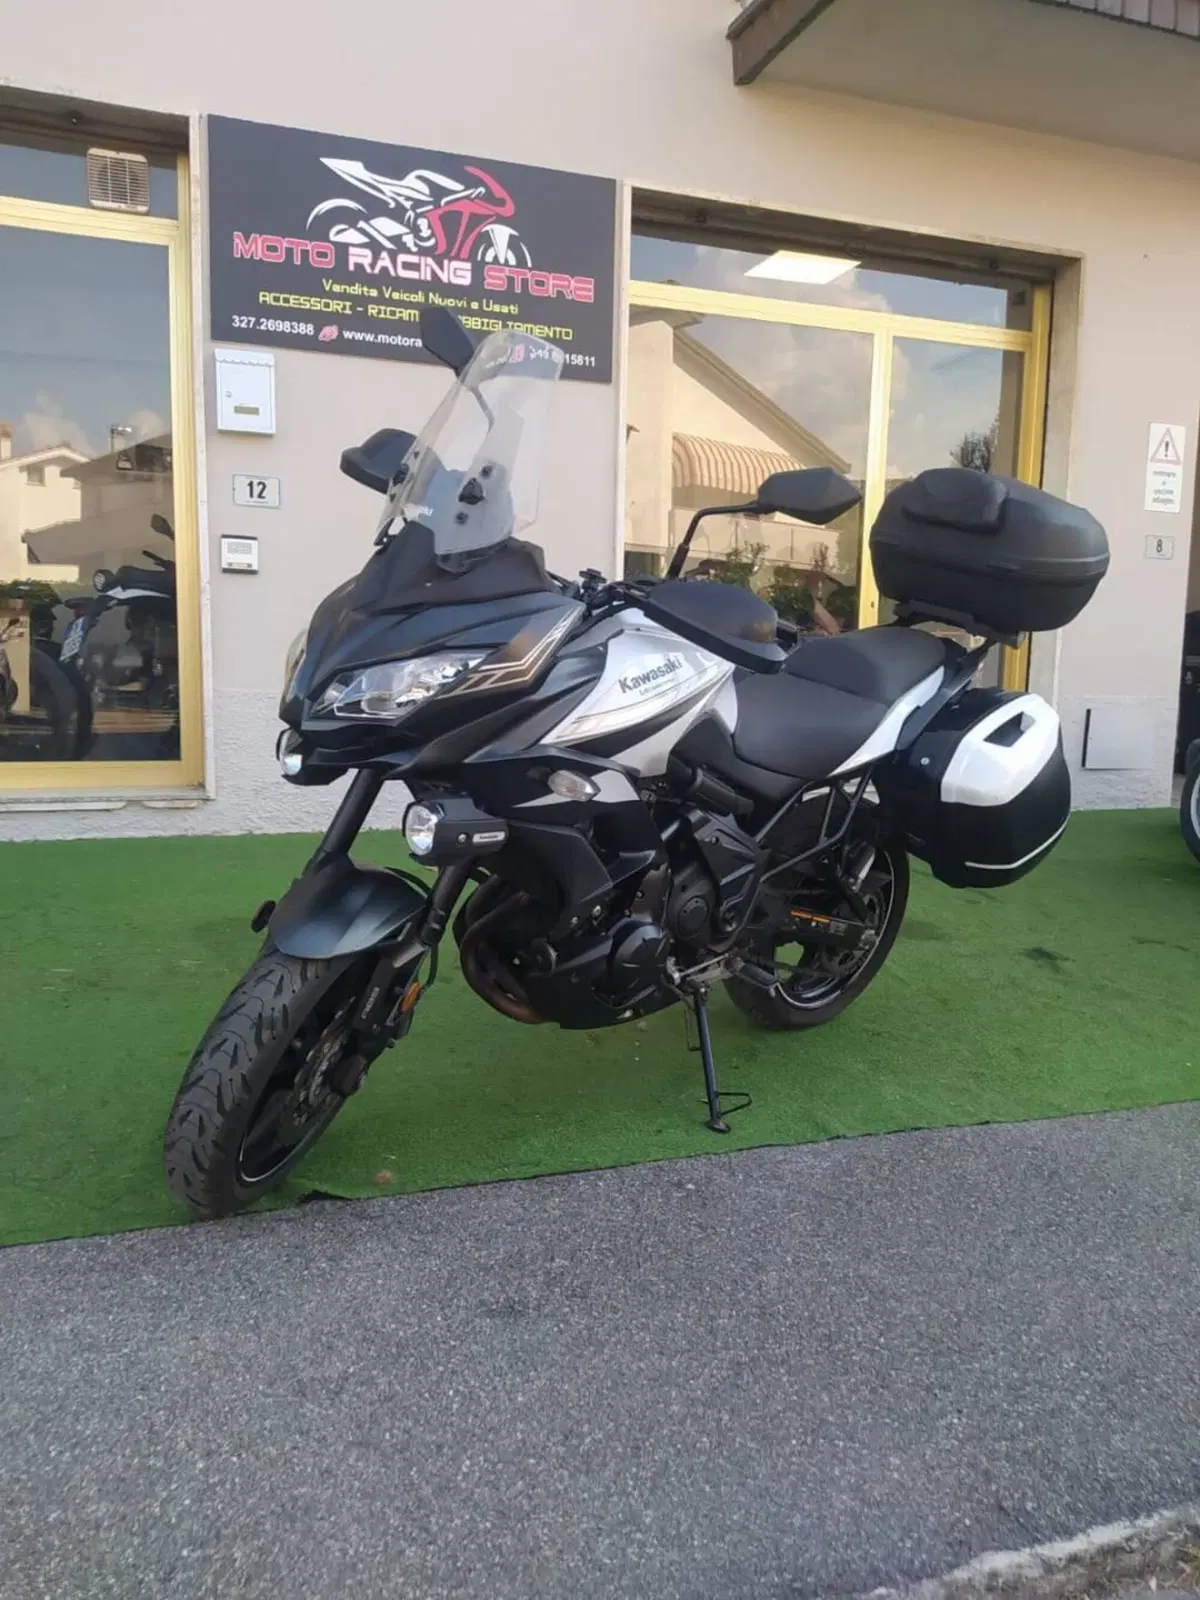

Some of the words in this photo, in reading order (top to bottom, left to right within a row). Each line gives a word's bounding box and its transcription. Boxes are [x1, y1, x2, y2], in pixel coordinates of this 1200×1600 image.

[233, 231, 336, 269] MOTO
[347, 245, 473, 287] RACING
[483, 264, 595, 304] STORE
[321, 277, 378, 298] Vendita
[382, 285, 425, 303] Veicoli
[429, 292, 467, 309] Nuovi
[483, 298, 519, 315] Usati
[231, 314, 315, 336] 327.2698388
[341, 328, 423, 348] www.motora
[258, 291, 353, 315] ACCESSORI
[367, 304, 421, 323] RICAM
[457, 314, 574, 341] BBIGLIAMENTO
[246, 479, 268, 500] 12
[1155, 537, 1164, 554] 8
[617, 654, 684, 694] Kawasaki
